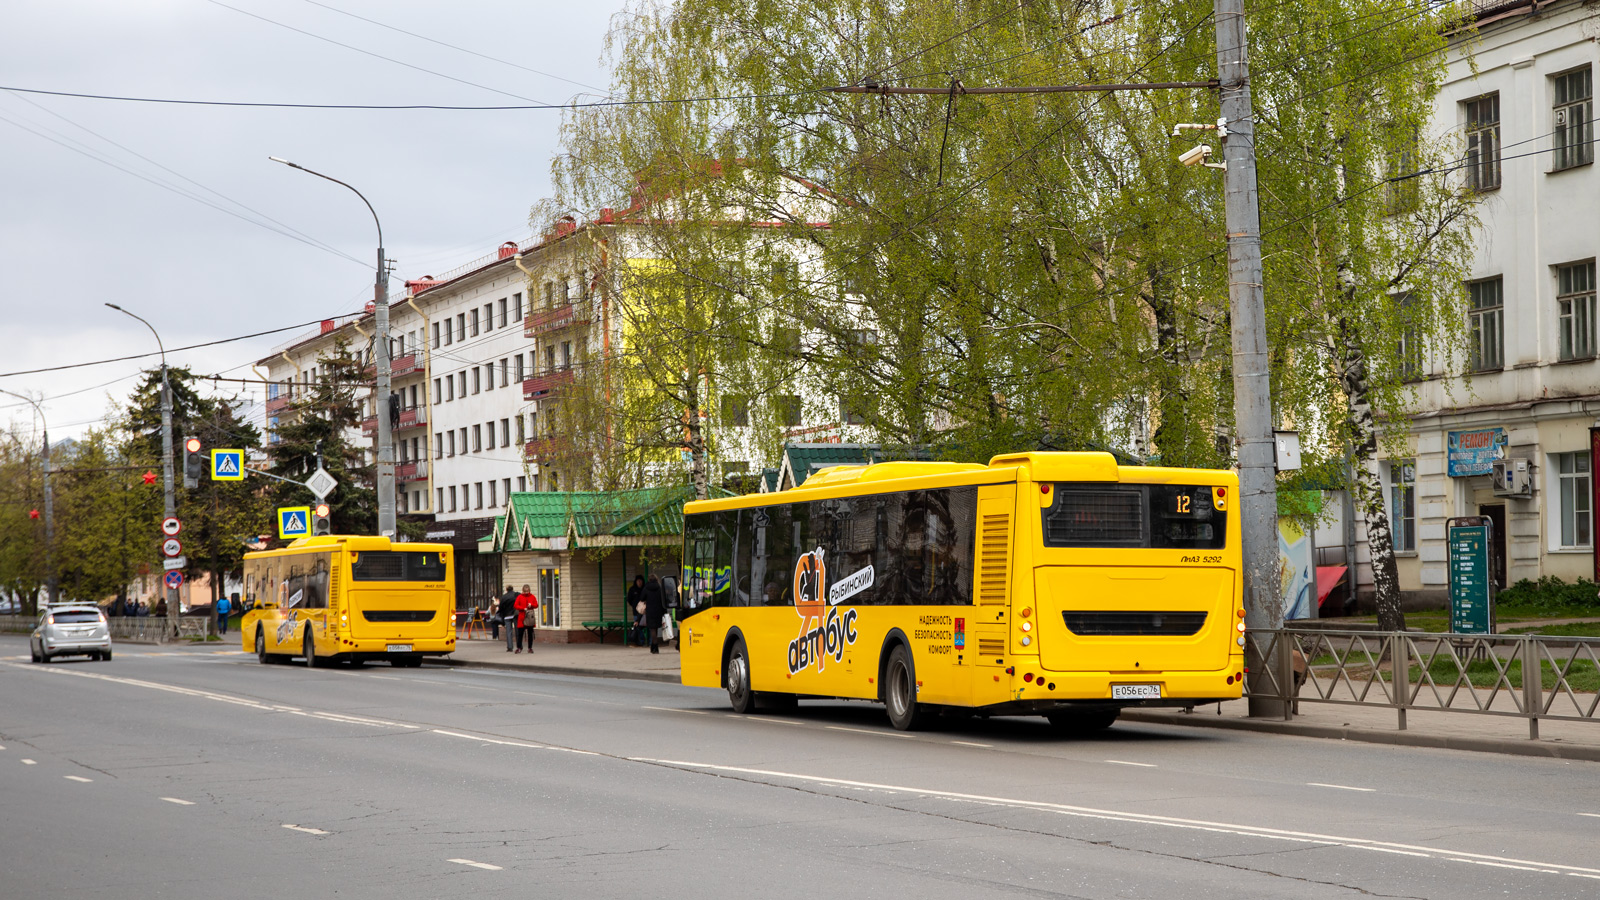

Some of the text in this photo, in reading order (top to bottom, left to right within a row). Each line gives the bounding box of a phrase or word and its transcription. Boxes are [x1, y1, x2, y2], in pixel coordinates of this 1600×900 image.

[1459, 431, 1495, 449] РЕМОНТ
[1176, 495, 1190, 513] 12
[422, 555, 427, 566] 1
[1203, 555, 1222, 563] 5292
[831, 567, 873, 600] РЫБИНСКИЙ
[919, 615, 952, 626] НАДЕЖНОСТЬ
[788, 605, 858, 674] автобус
[915, 629, 952, 640] БЕЗОПАСНОСТЬ
[928, 644, 952, 655] КОМФОРТ
